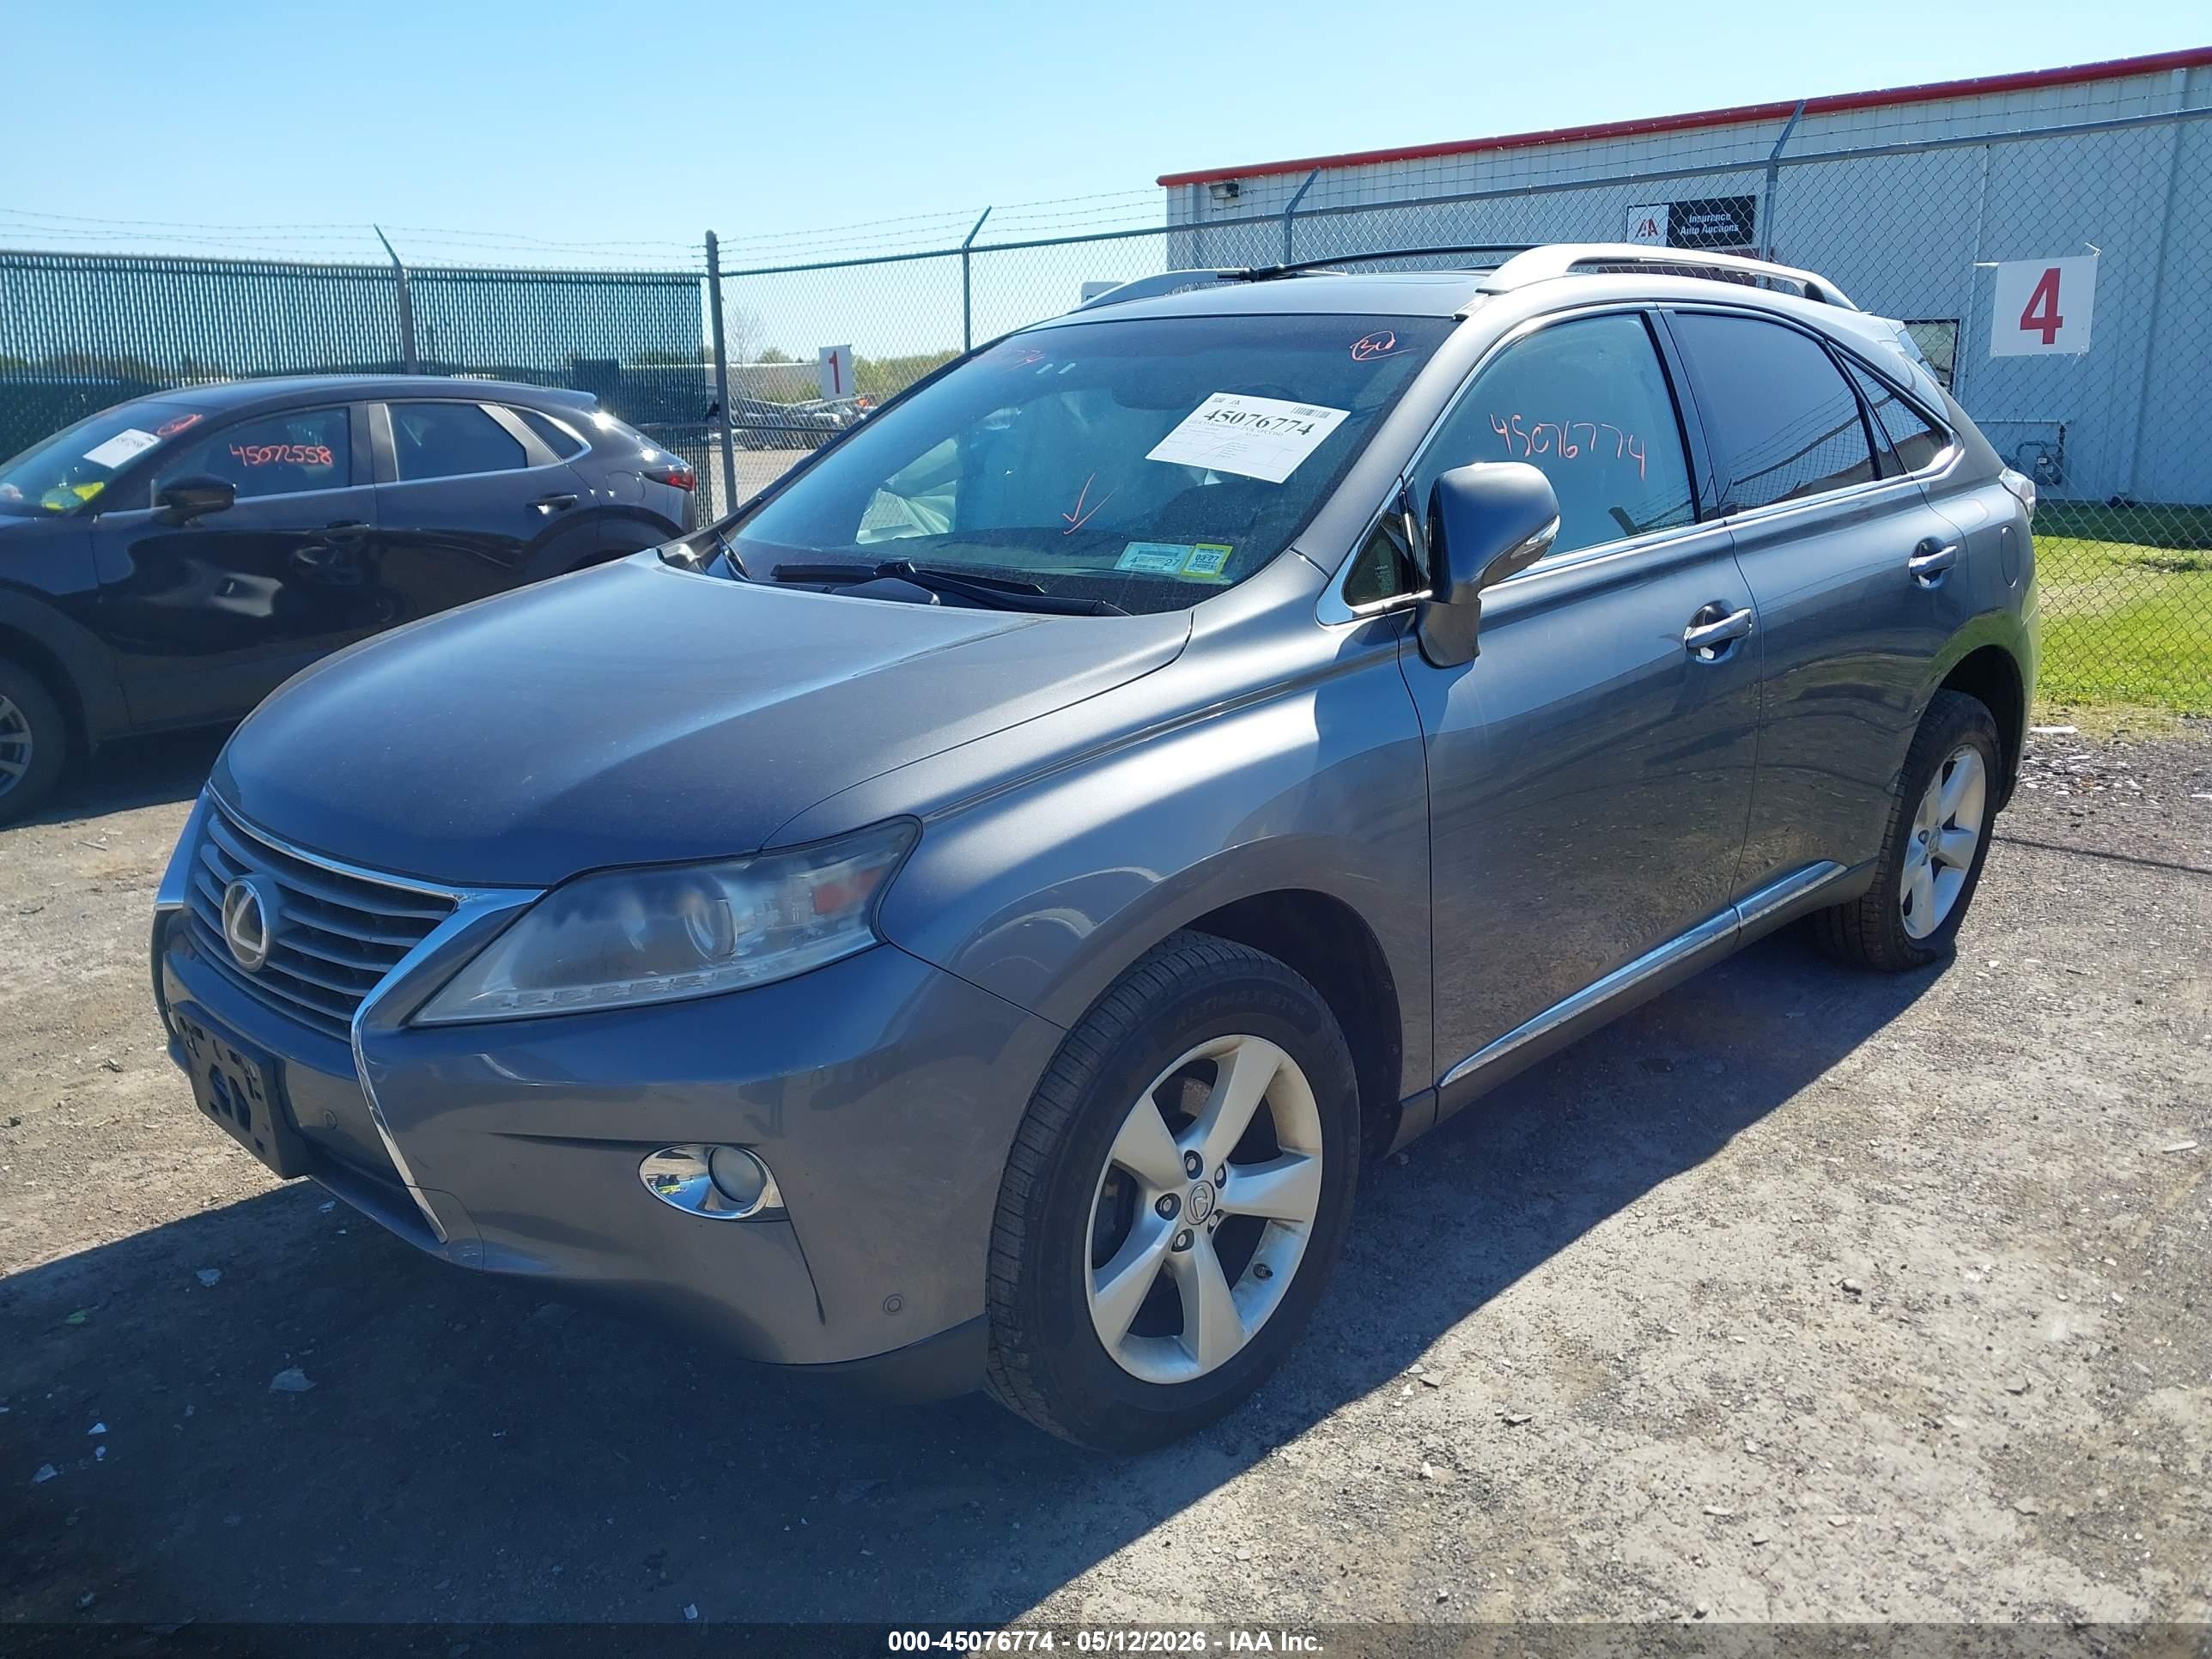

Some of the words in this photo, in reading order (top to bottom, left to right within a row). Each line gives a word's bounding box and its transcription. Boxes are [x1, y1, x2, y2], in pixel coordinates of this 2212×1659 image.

[1680, 226, 1700, 236] Auto
[1701, 222, 1739, 234] Auctions
[1688, 213, 1731, 223] Insurance
[2020, 267, 2063, 344] 4
[828, 350, 841, 394] 1
[1203, 409, 1316, 435] 45076774
[228, 442, 334, 468] 45072558
[1490, 413, 1645, 481] 45076774
[1164, 558, 1182, 567] 27
